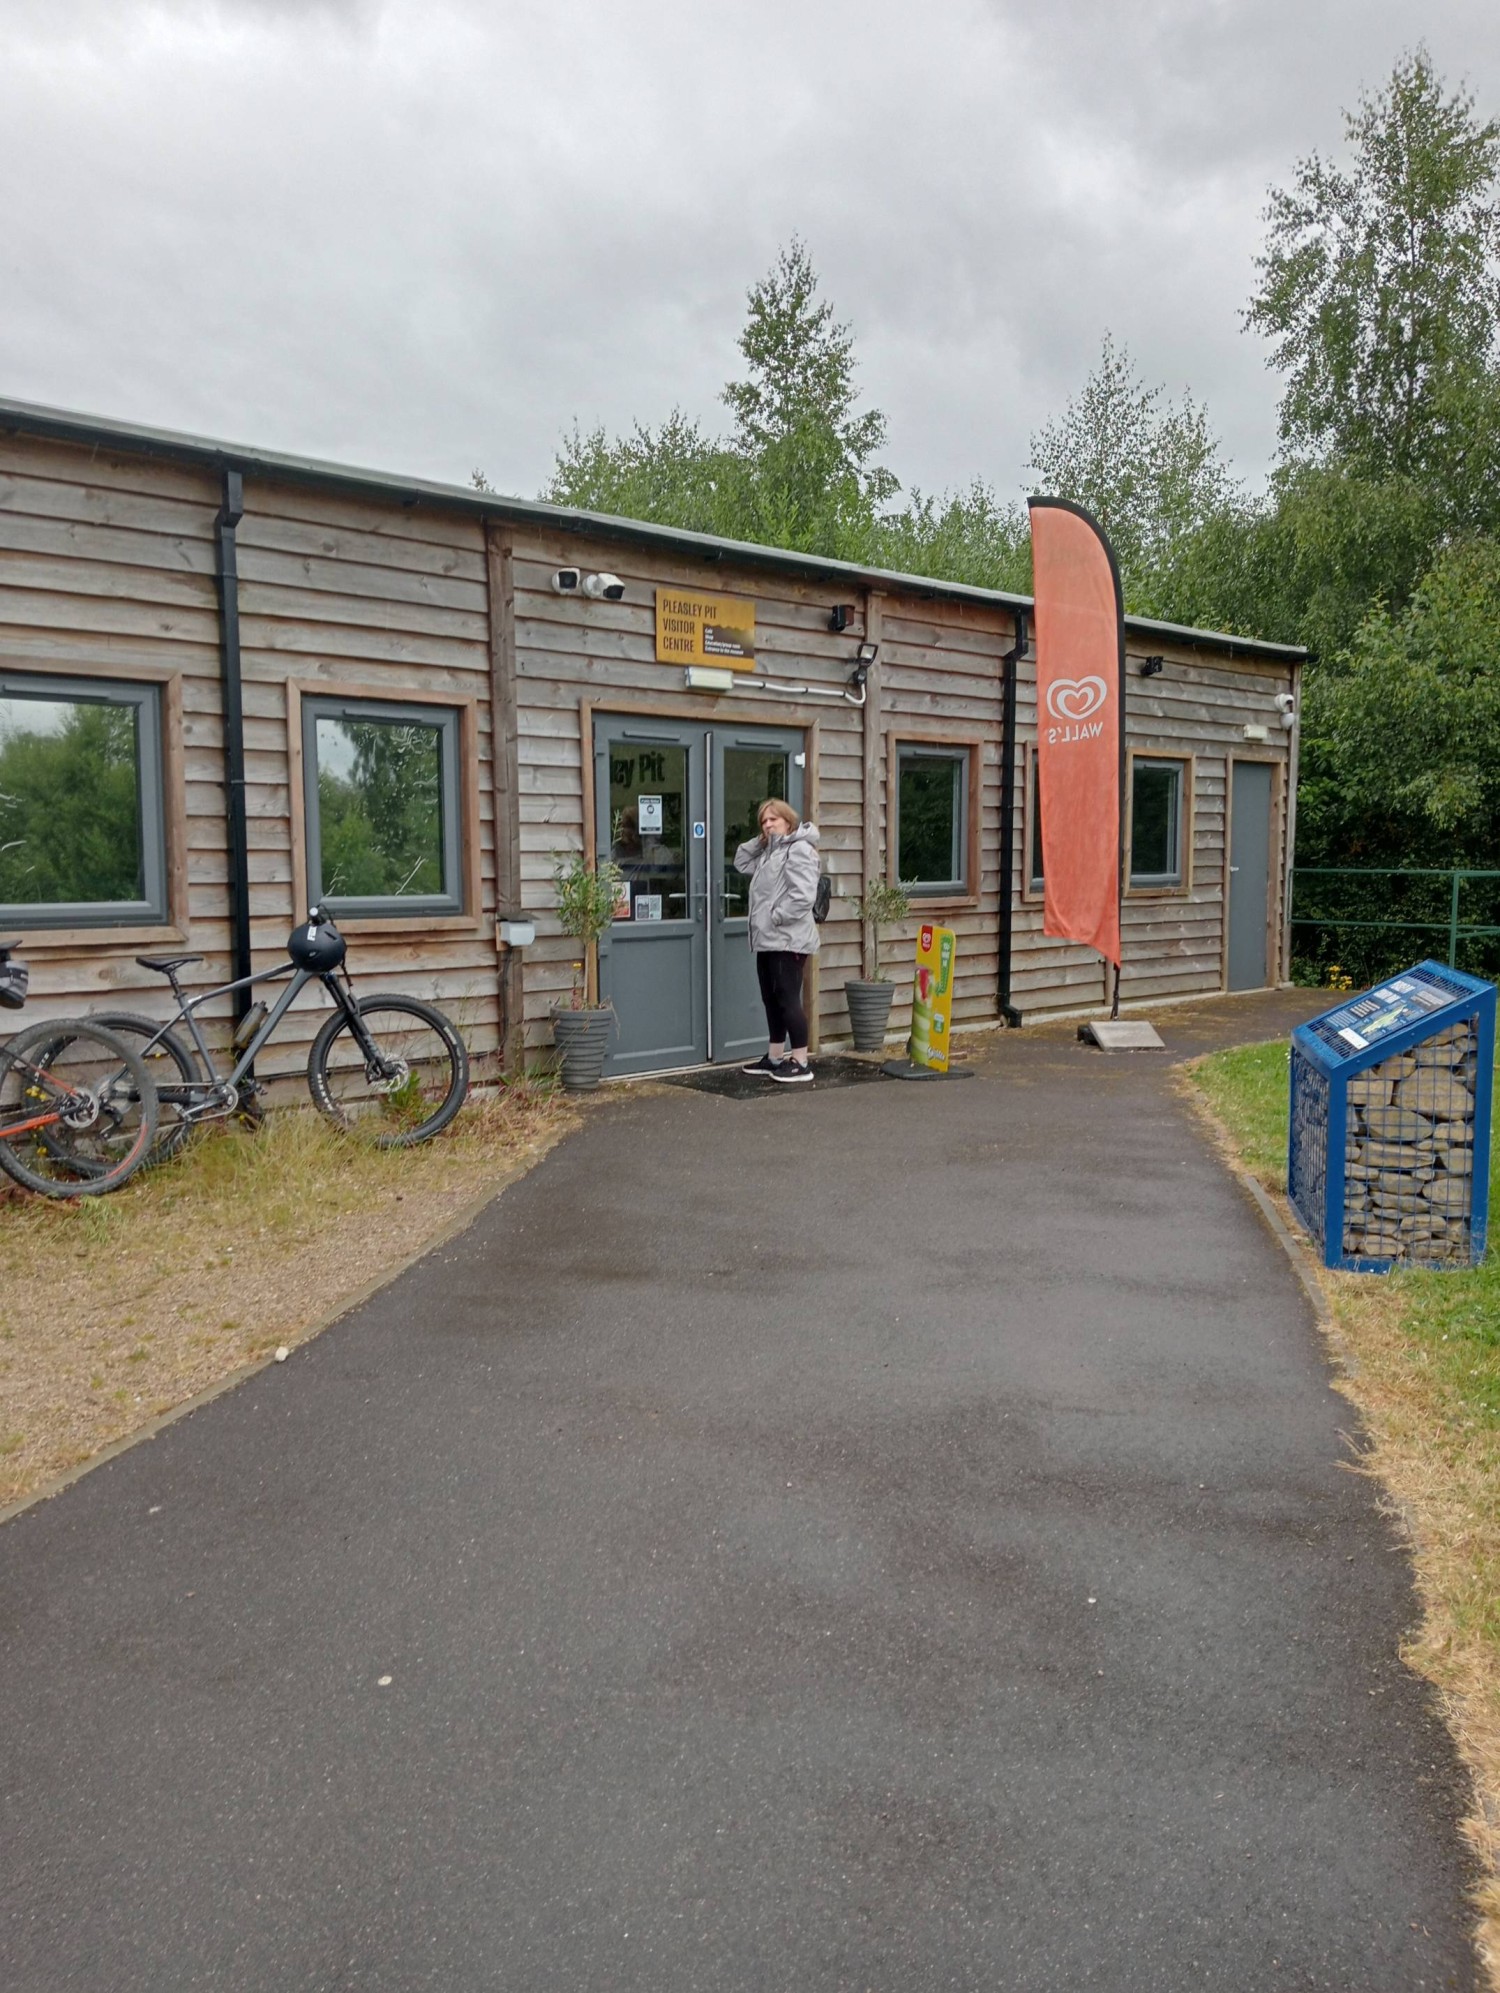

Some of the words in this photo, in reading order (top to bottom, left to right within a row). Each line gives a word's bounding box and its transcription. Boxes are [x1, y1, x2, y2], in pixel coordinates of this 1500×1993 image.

[662, 599, 702, 617] PLEASLEY
[704, 605, 717, 619] PIT
[662, 618, 695, 634] VISITOR
[663, 636, 694, 653] CENTRE
[639, 751, 665, 783] Pit
